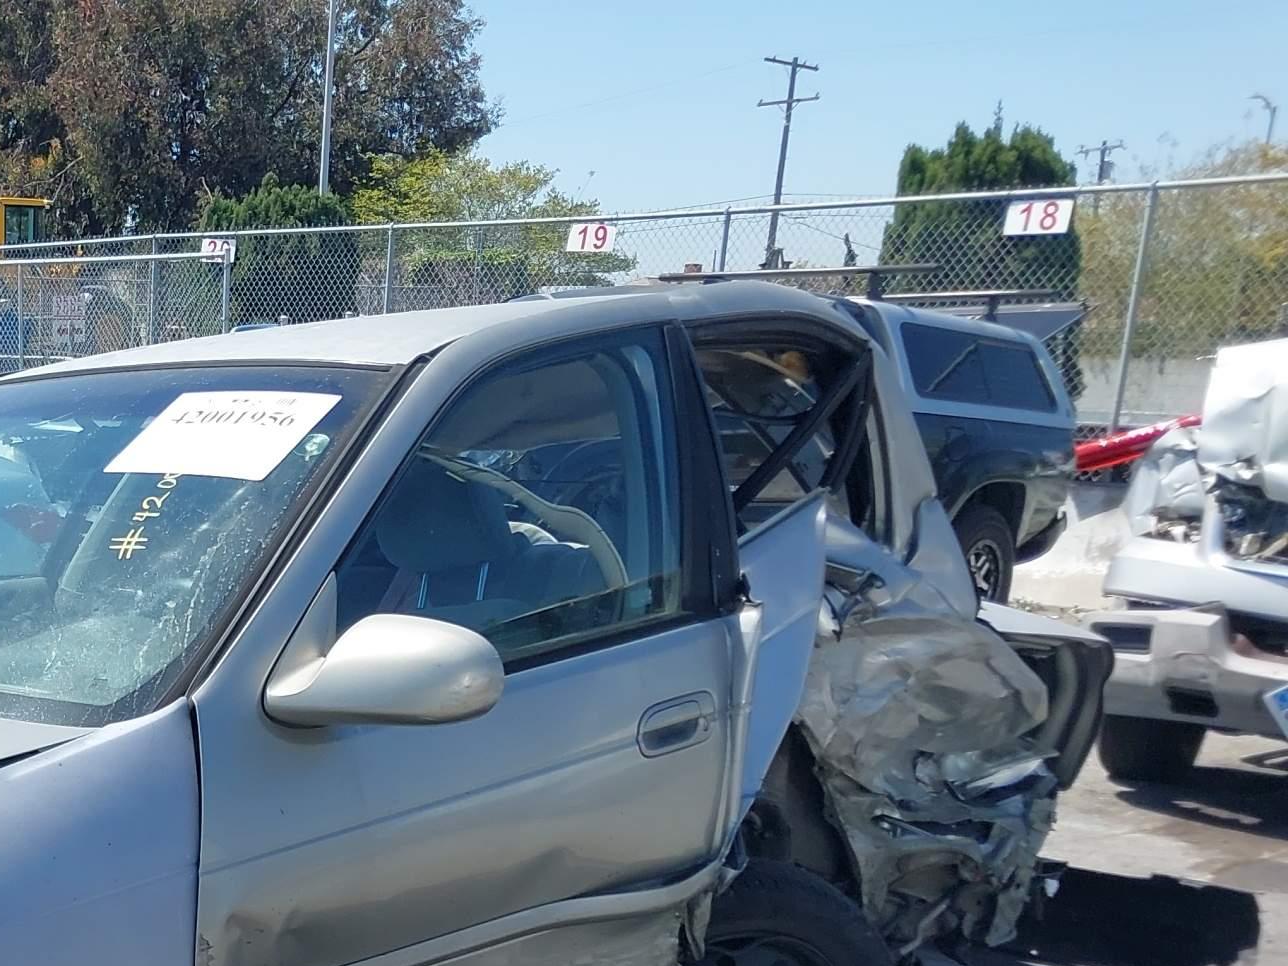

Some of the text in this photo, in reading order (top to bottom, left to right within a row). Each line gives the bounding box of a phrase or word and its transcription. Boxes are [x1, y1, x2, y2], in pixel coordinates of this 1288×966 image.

[1020, 201, 1059, 231] 18
[578, 225, 608, 250] 19
[171, 410, 295, 426] 42001956
